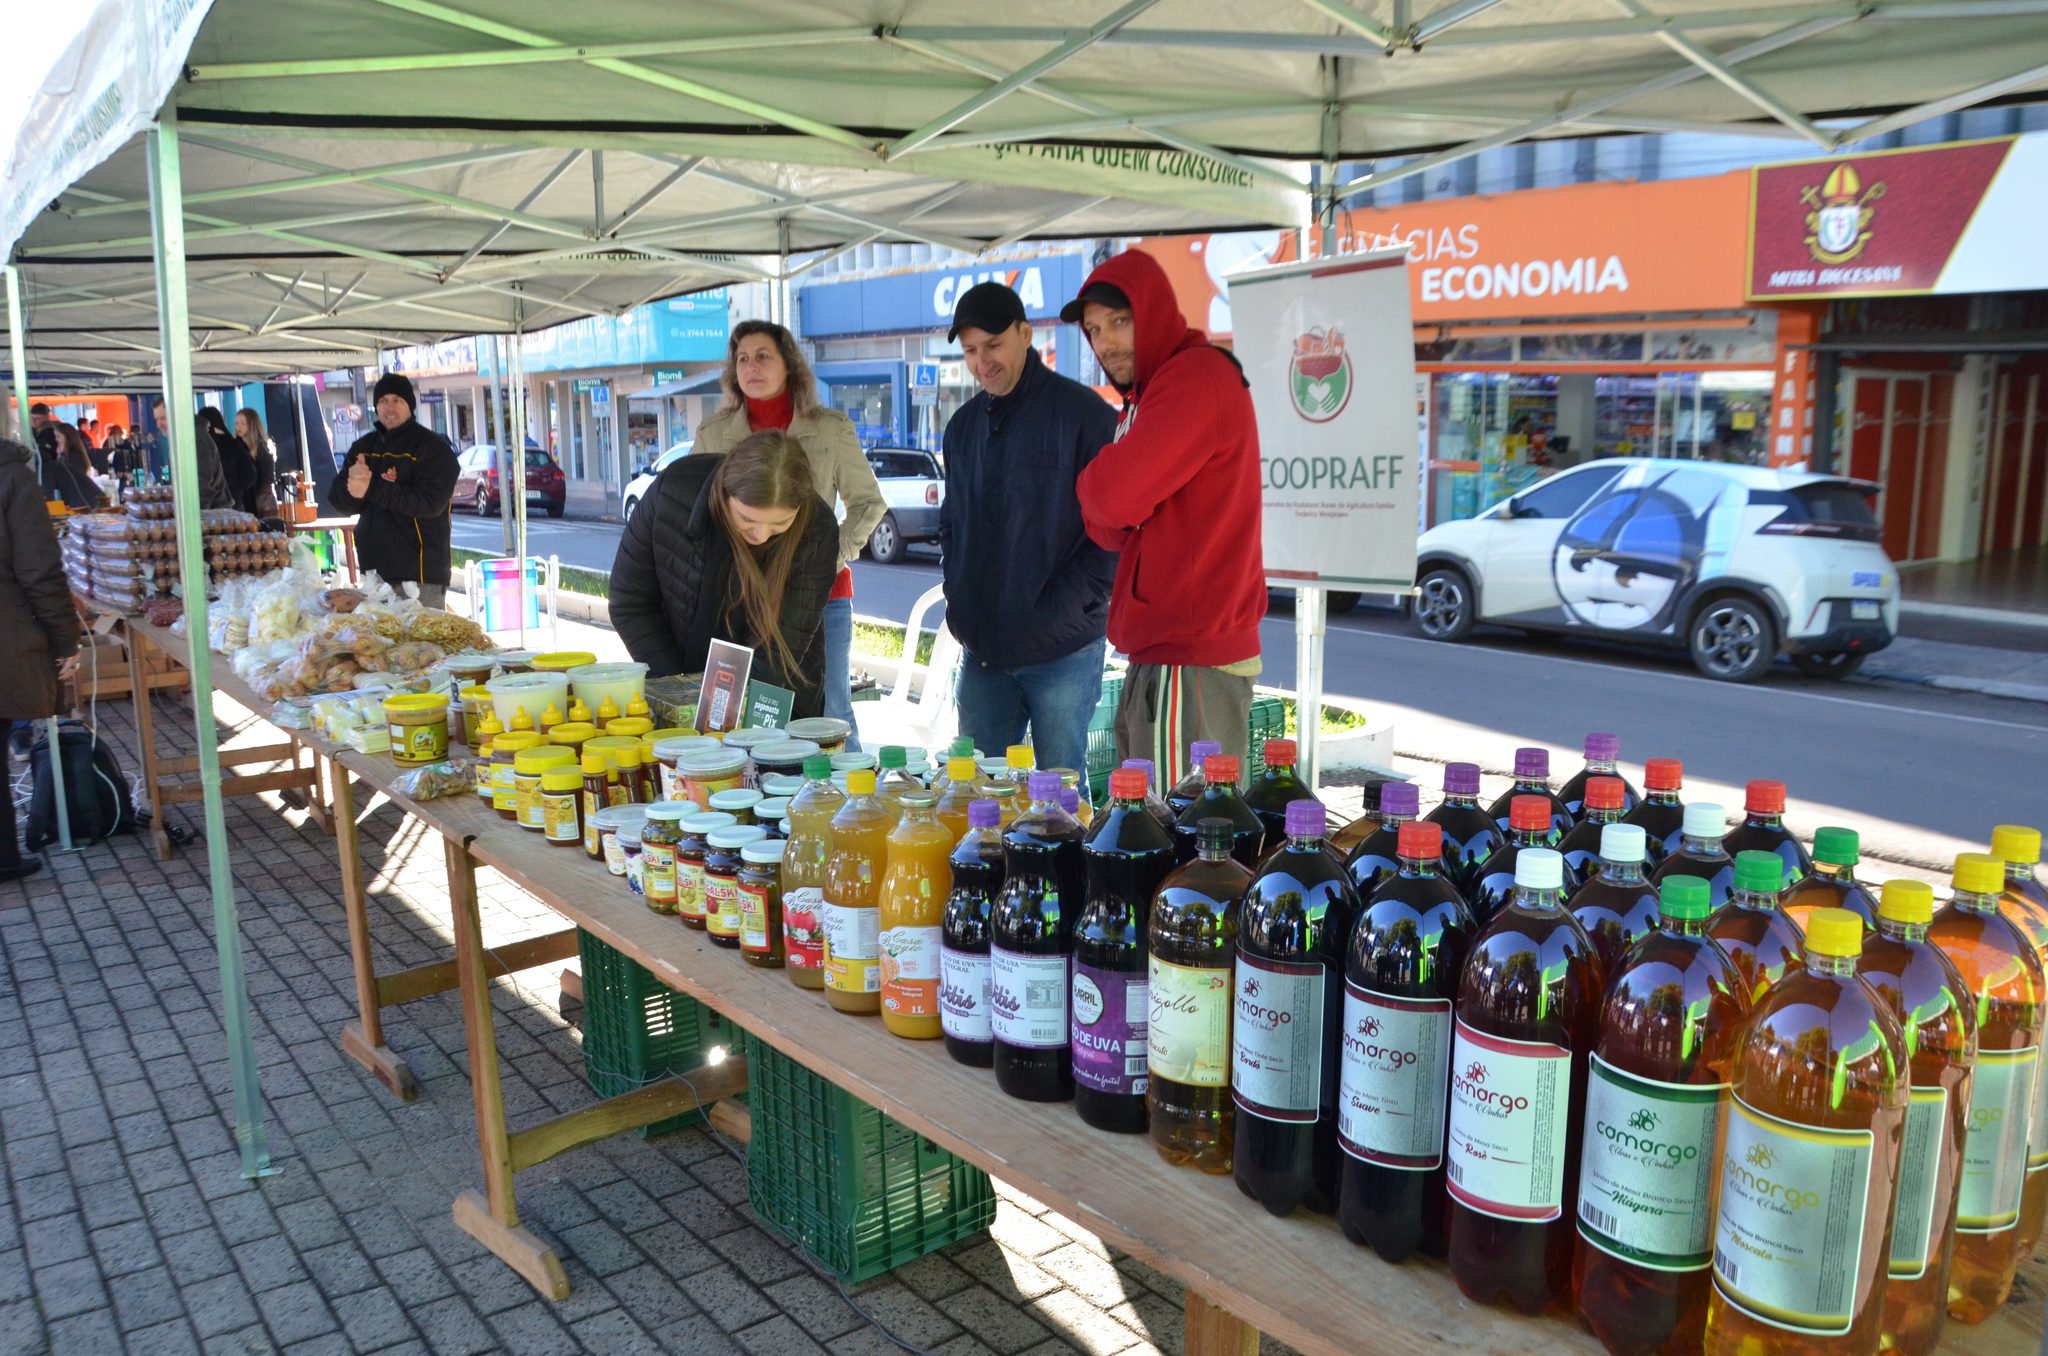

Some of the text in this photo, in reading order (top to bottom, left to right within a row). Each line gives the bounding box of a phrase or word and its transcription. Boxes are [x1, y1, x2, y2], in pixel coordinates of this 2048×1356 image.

[1421, 255, 1629, 302] ECONOMIA
[933, 267, 1044, 317] CAXA
[763, 713, 778, 729] Pix
[893, 931, 924, 945] Casa
[962, 960, 976, 968] UVA
[1006, 959, 1019, 968] UVA
[911, 1005, 924, 1014] 1L
[1235, 993, 1291, 1027] amargo
[1080, 1031, 1092, 1048] DE
[1093, 1036, 1121, 1053] UVA
[1350, 1095, 1380, 1115] Suave
[1381, 1097, 1398, 1105] Tinto
[1474, 1137, 1490, 1147] Mesa
[1492, 1143, 1508, 1152] Seco
[1596, 1120, 1697, 1164] camargo
[1640, 1153, 1675, 1170] Vinhos
[1593, 1170, 1610, 1184] Vinho
[1611, 1180, 1620, 1188] de
[1621, 1184, 1641, 1196] Mesa
[1642, 1192, 1673, 1203] Branco
[1611, 1189, 1663, 1216] Niágara
[1754, 1233, 1782, 1248] Branco
[1783, 1243, 1804, 1254] Seco
